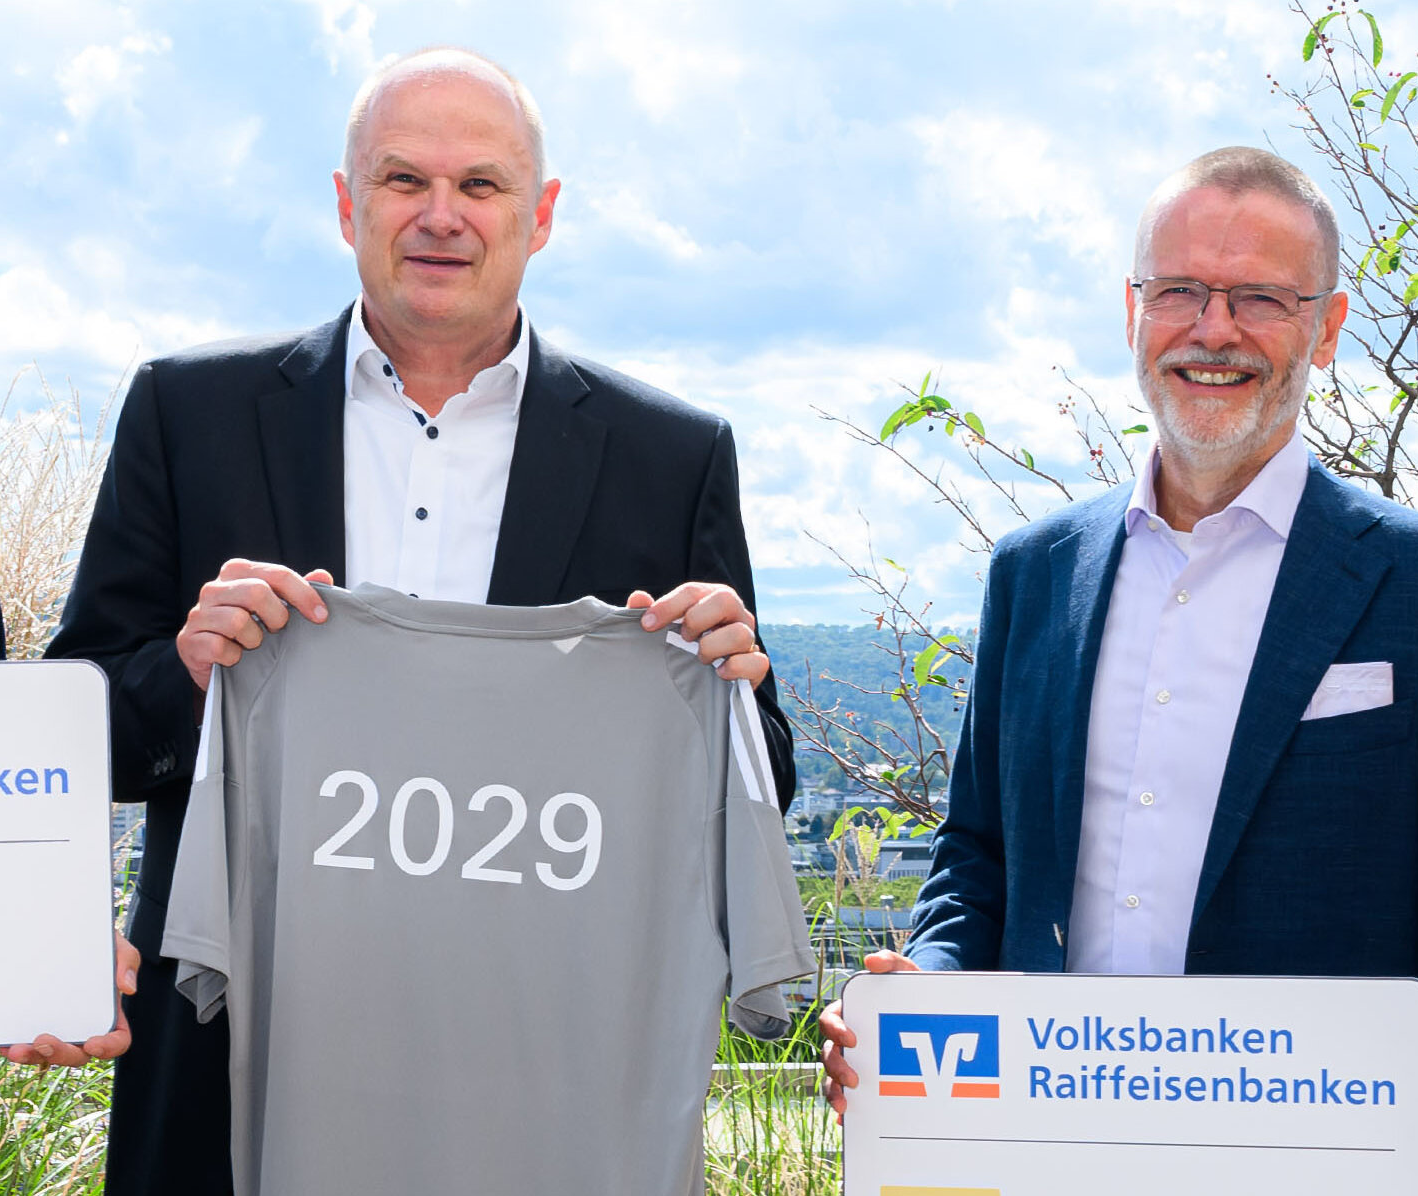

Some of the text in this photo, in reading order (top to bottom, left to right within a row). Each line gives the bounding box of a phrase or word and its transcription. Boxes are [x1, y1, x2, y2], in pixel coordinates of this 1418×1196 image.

[313, 770, 603, 891] 2029
[1027, 1015, 1294, 1055] Volksbanken
[1028, 1064, 1397, 1106] Raiffeisenbanken
